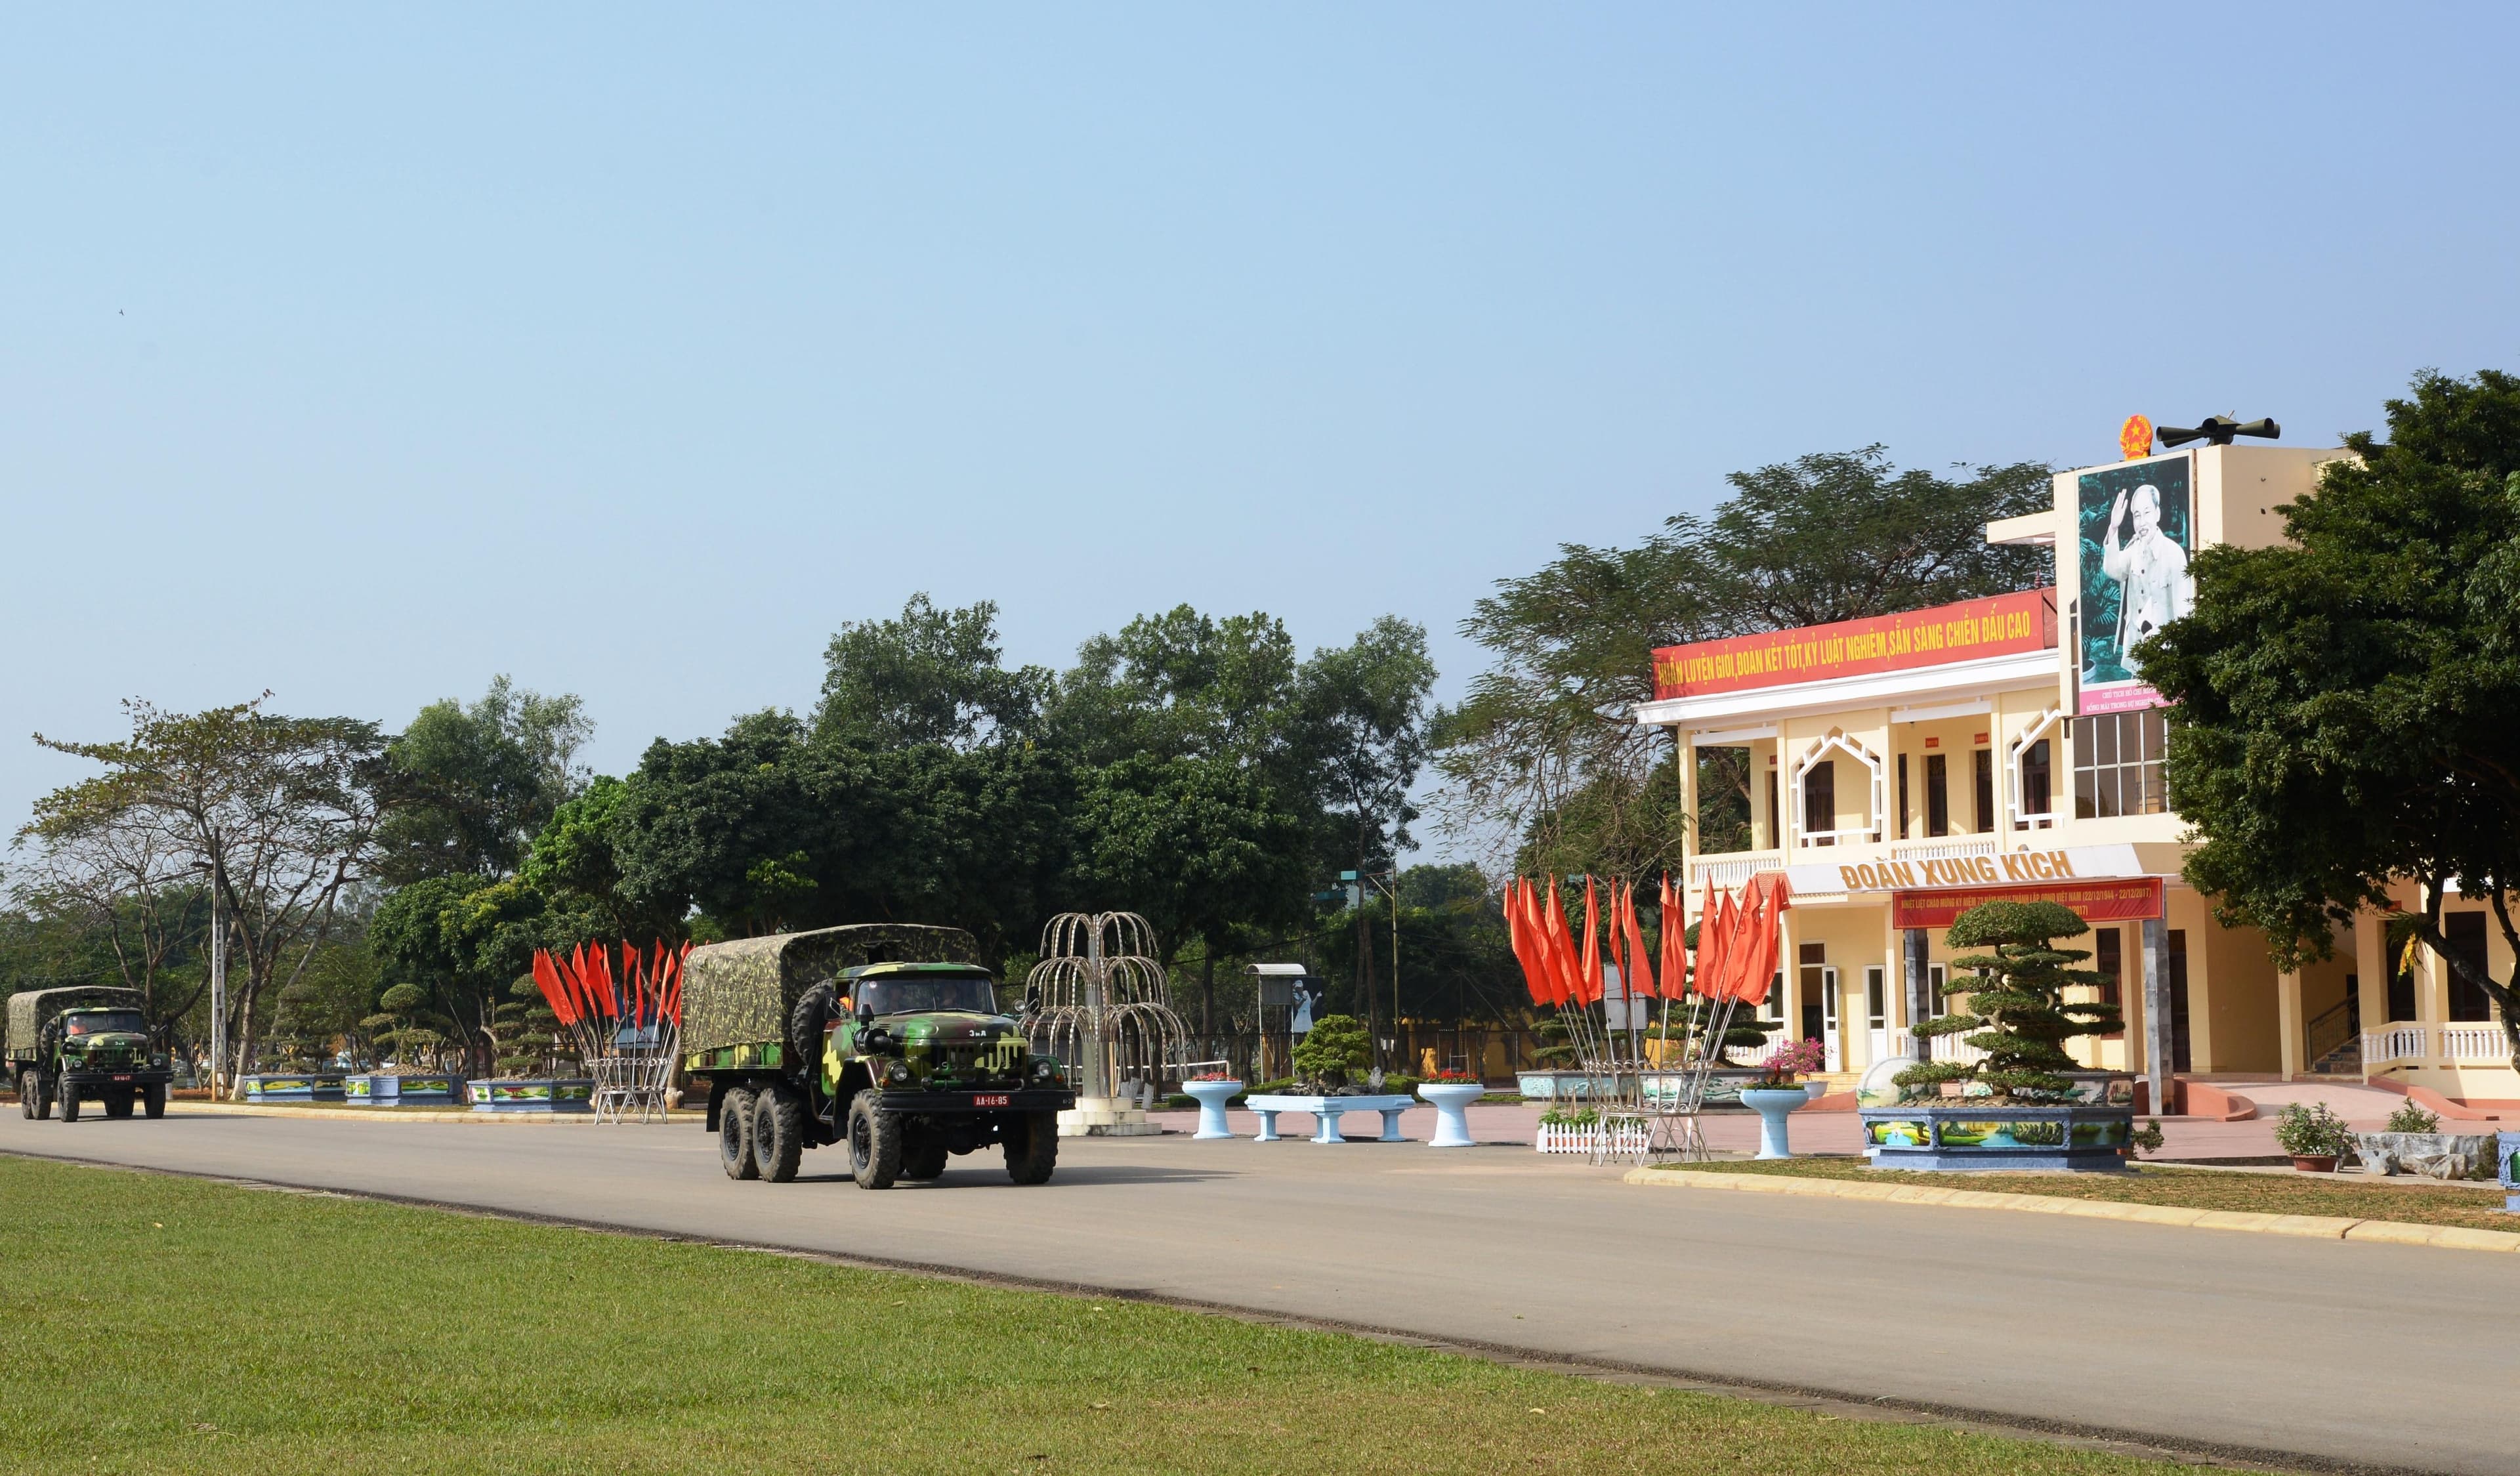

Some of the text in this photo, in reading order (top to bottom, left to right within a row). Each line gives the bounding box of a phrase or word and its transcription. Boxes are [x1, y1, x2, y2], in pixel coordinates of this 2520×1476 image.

[1658, 651, 1683, 686] HUẤN
[1684, 652, 1715, 685] LUYỆN
[1765, 637, 1782, 672] KẾT
[1820, 633, 1843, 668] LUẬT
[1914, 620, 1944, 652] SÀNG
[1946, 608, 1980, 648] CHIẾN
[1982, 602, 2005, 643] ĐẤU
[2007, 610, 2030, 640] CAO
[2114, 690, 2124, 699] TỊCH
[1839, 844, 2075, 889] ĐOÀN XUNG KÍCH
[1901, 898, 1914, 911] NHIỆT
[1916, 898, 1925, 911] LIỆT
[1926, 896, 1939, 908] CHÀO
[2056, 890, 2067, 904] VIỆT
[2068, 891, 2082, 902] NAM
[2082, 889, 2114, 902] (22/12/1944
[2119, 887, 2152, 898] 22/12/2017)
[976, 1096, 1007, 1105] AA-16-85
